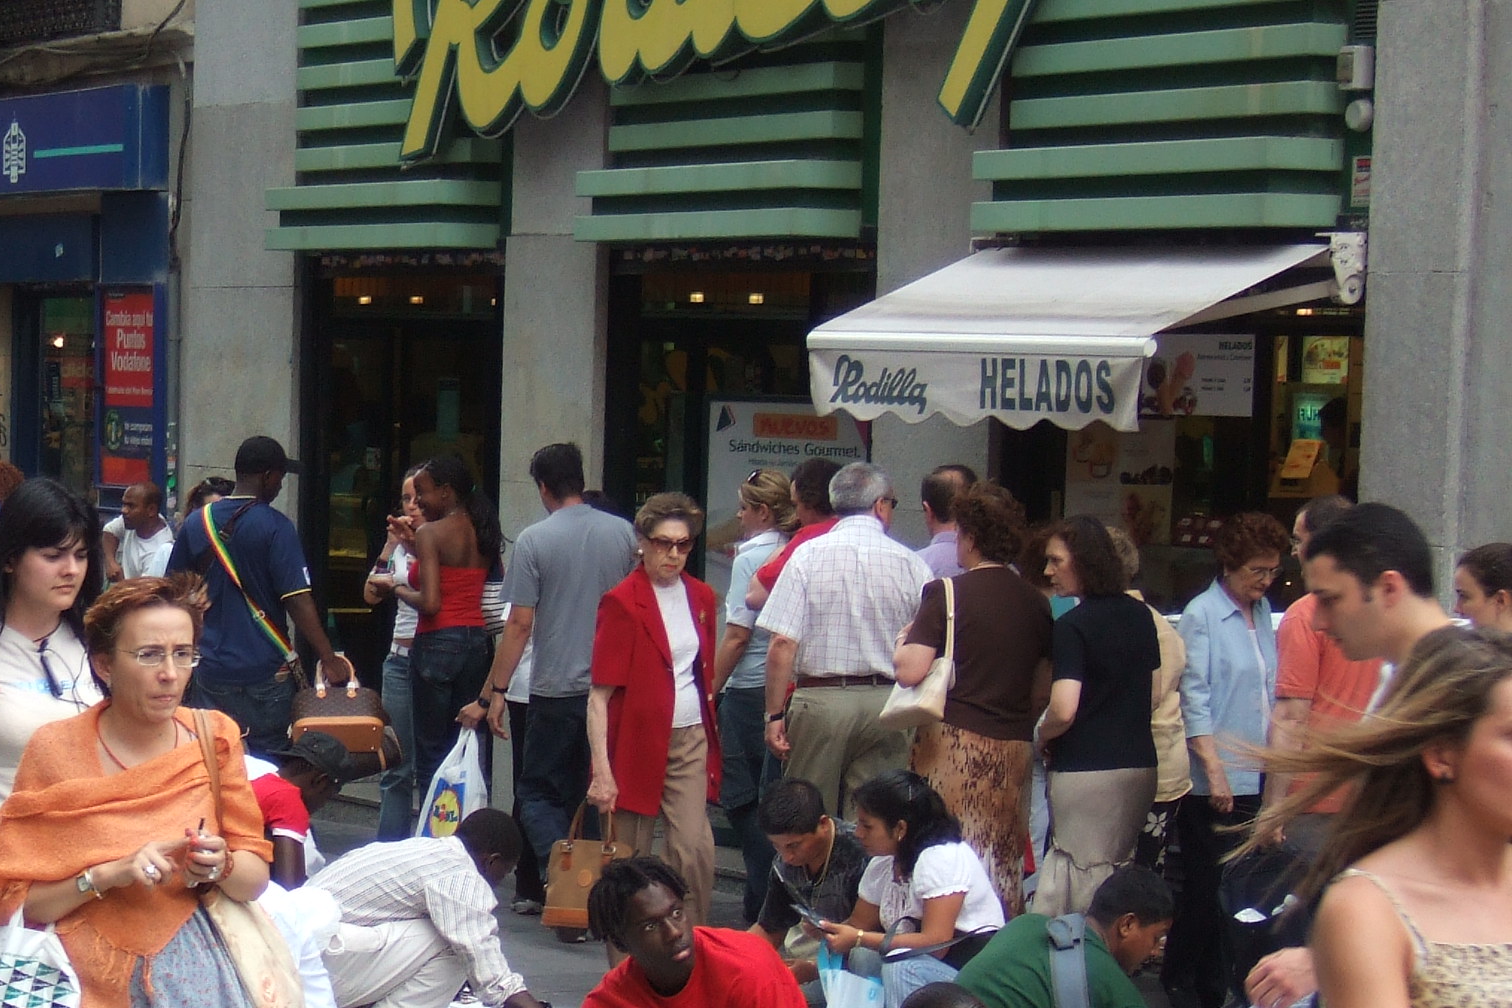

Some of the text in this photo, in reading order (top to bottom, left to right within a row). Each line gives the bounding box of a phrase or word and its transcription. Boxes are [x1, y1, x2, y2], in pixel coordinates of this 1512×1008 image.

[116, 329, 146, 350] Puntos
[111, 352, 151, 372] Vodafone
[829, 354, 928, 414] Rodilla
[979, 358, 1116, 414] HELADOS
